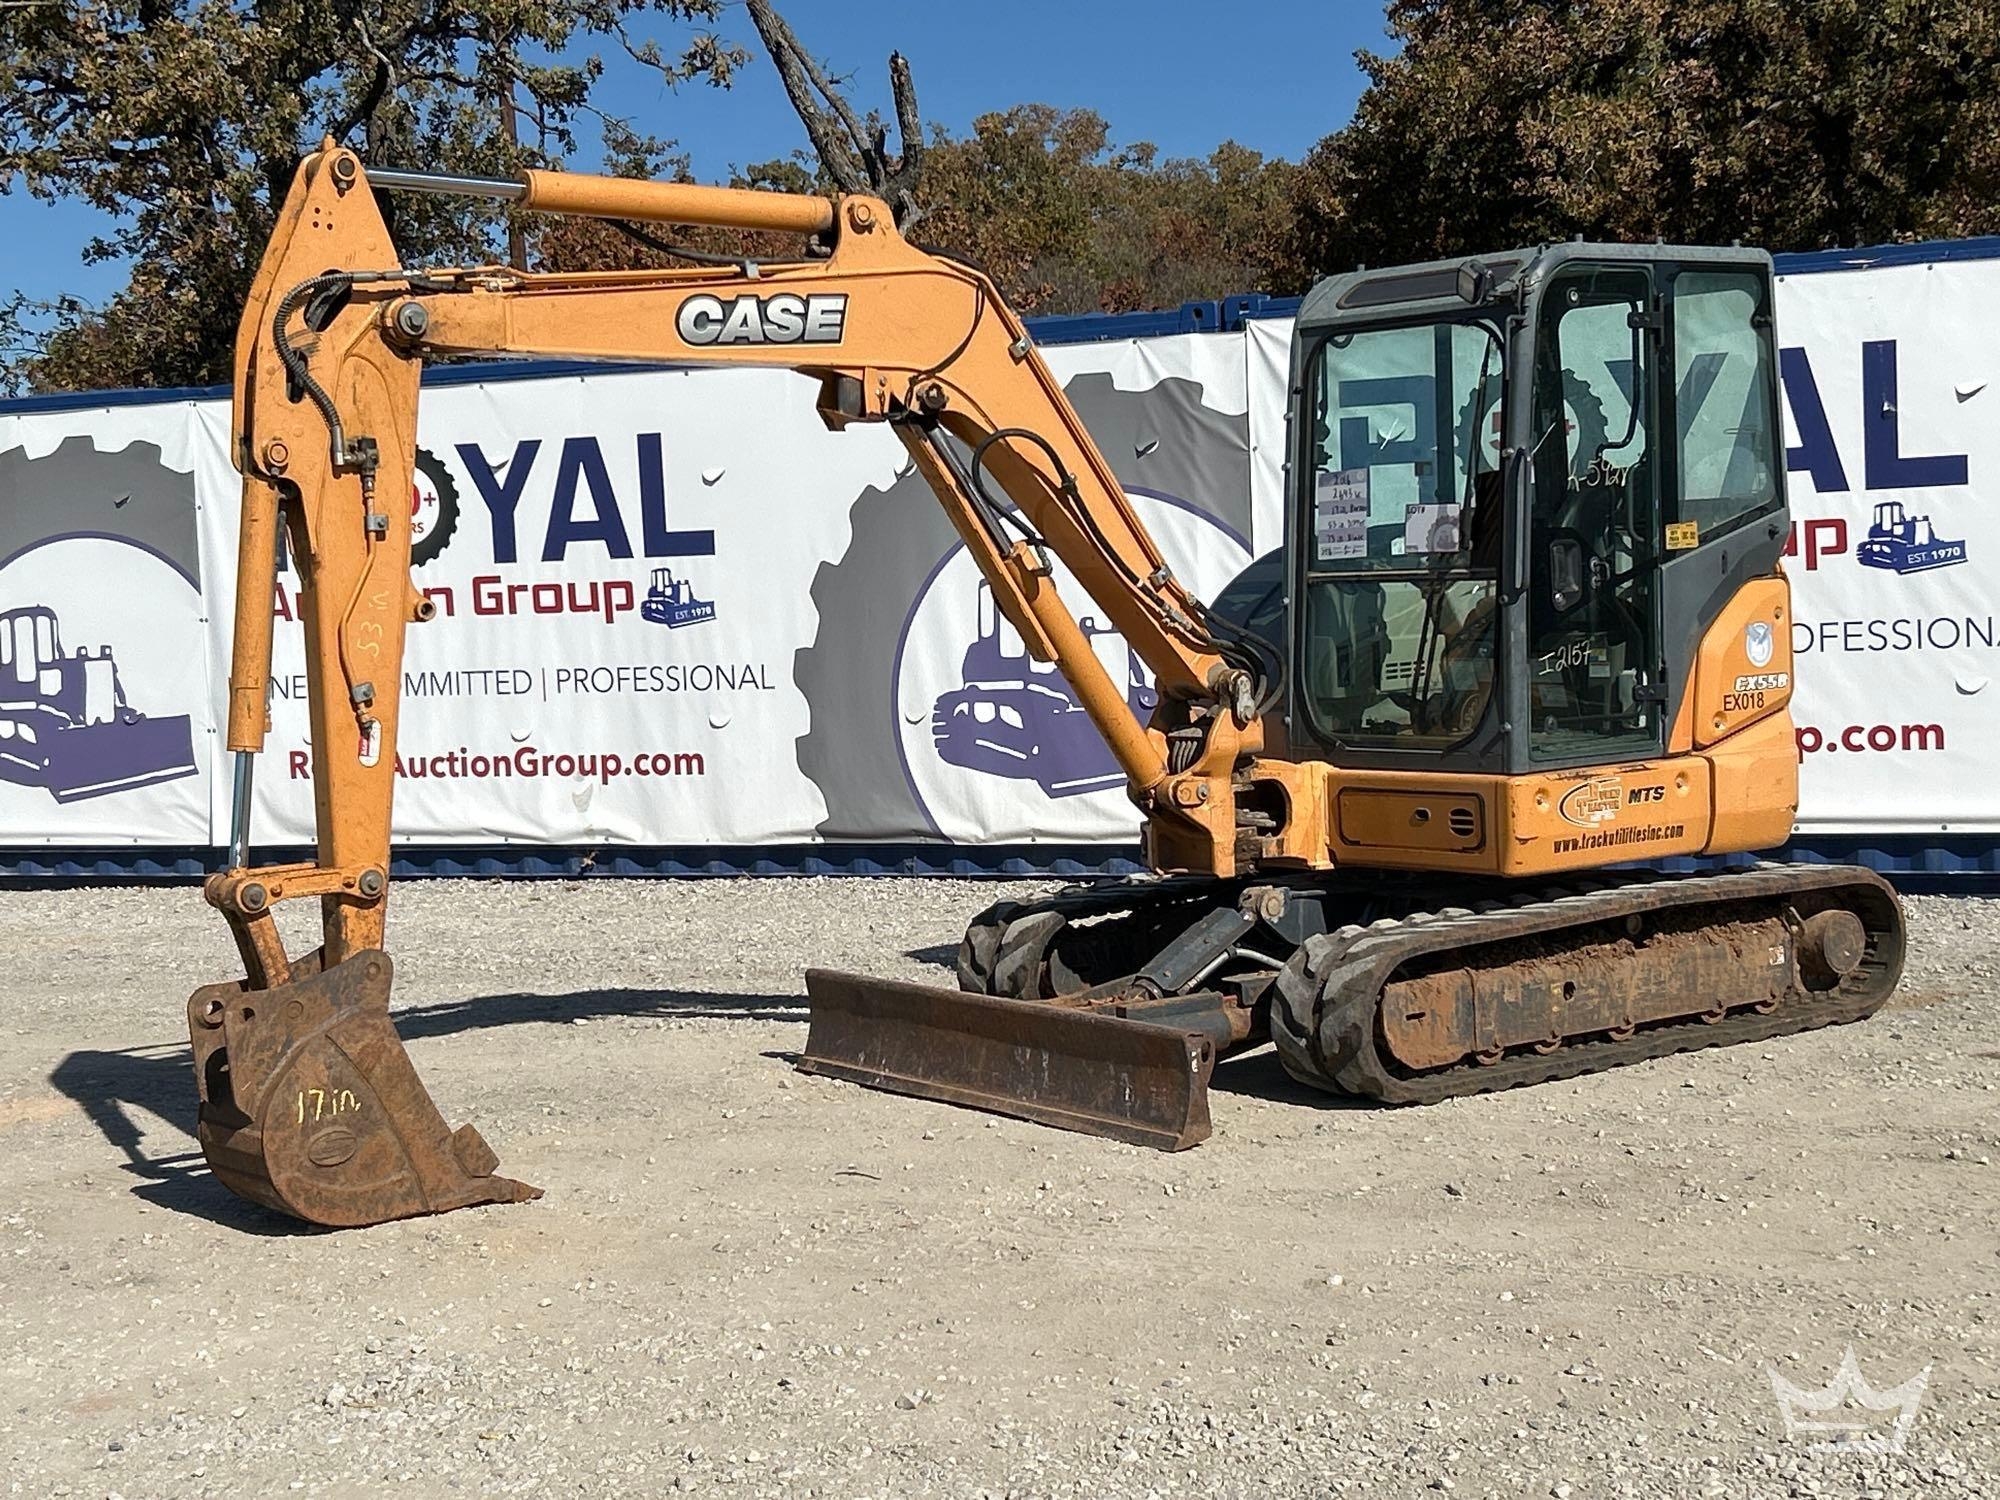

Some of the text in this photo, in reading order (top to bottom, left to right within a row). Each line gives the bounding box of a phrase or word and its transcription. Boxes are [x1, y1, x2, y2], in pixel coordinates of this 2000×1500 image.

[677, 294, 848, 346] CASE
[412, 432, 716, 565] YAL
[1907, 546, 1961, 564] EST. 1970
[472, 575, 635, 624] Group
[675, 606, 712, 620] EST. 1970
[1792, 616, 2000, 653] OFESSION
[404, 663, 776, 697] MMITTED PROFESSIONAL
[1723, 692, 1765, 711] EX018
[1628, 786, 1666, 804] MTS
[297, 1089, 325, 1124] 17
